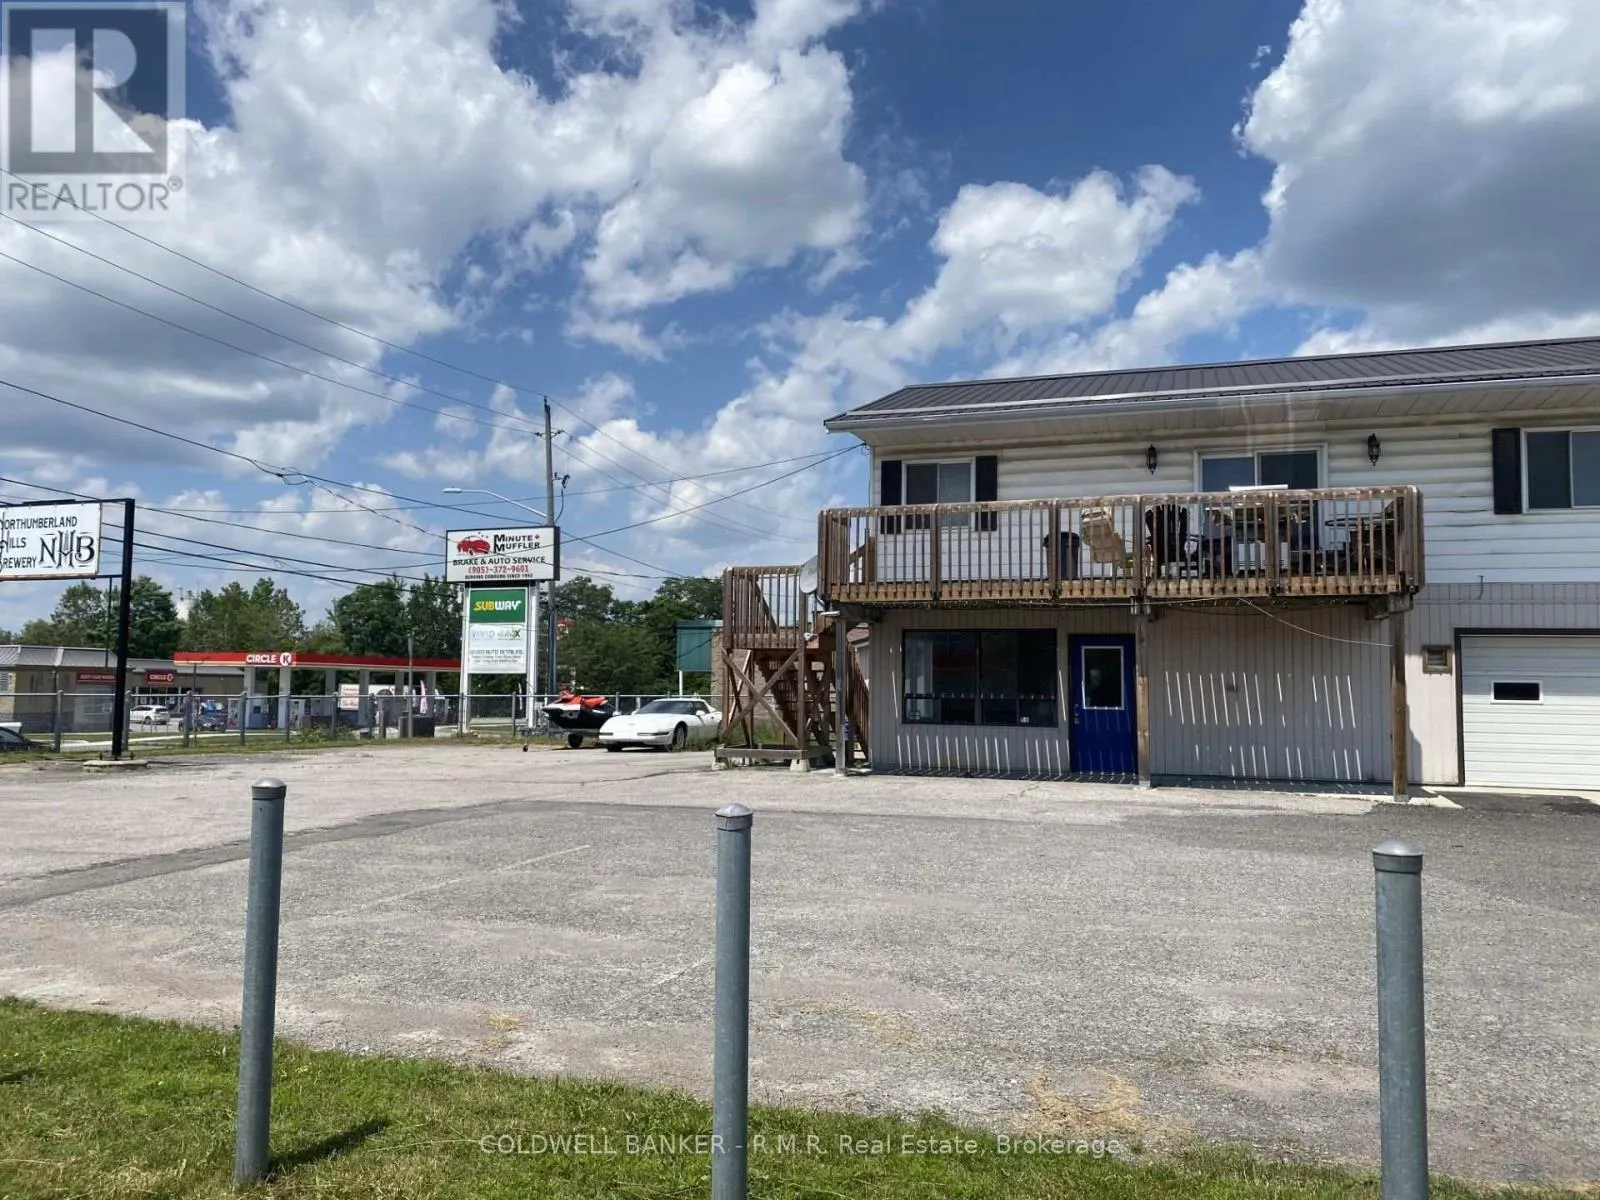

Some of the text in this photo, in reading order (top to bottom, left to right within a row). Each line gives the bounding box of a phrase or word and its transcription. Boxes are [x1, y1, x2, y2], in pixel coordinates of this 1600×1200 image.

[494, 534, 533, 543] MINUTE
[494, 542, 540, 553] MUFFLER
[0, 556, 37, 572] REWERY
[453, 558, 479, 566] BRAKE
[488, 557, 511, 565] AUTO
[512, 556, 546, 564] SERVICE
[474, 601, 521, 611] SUBWAY
[246, 652, 292, 666] CIRCLE K
